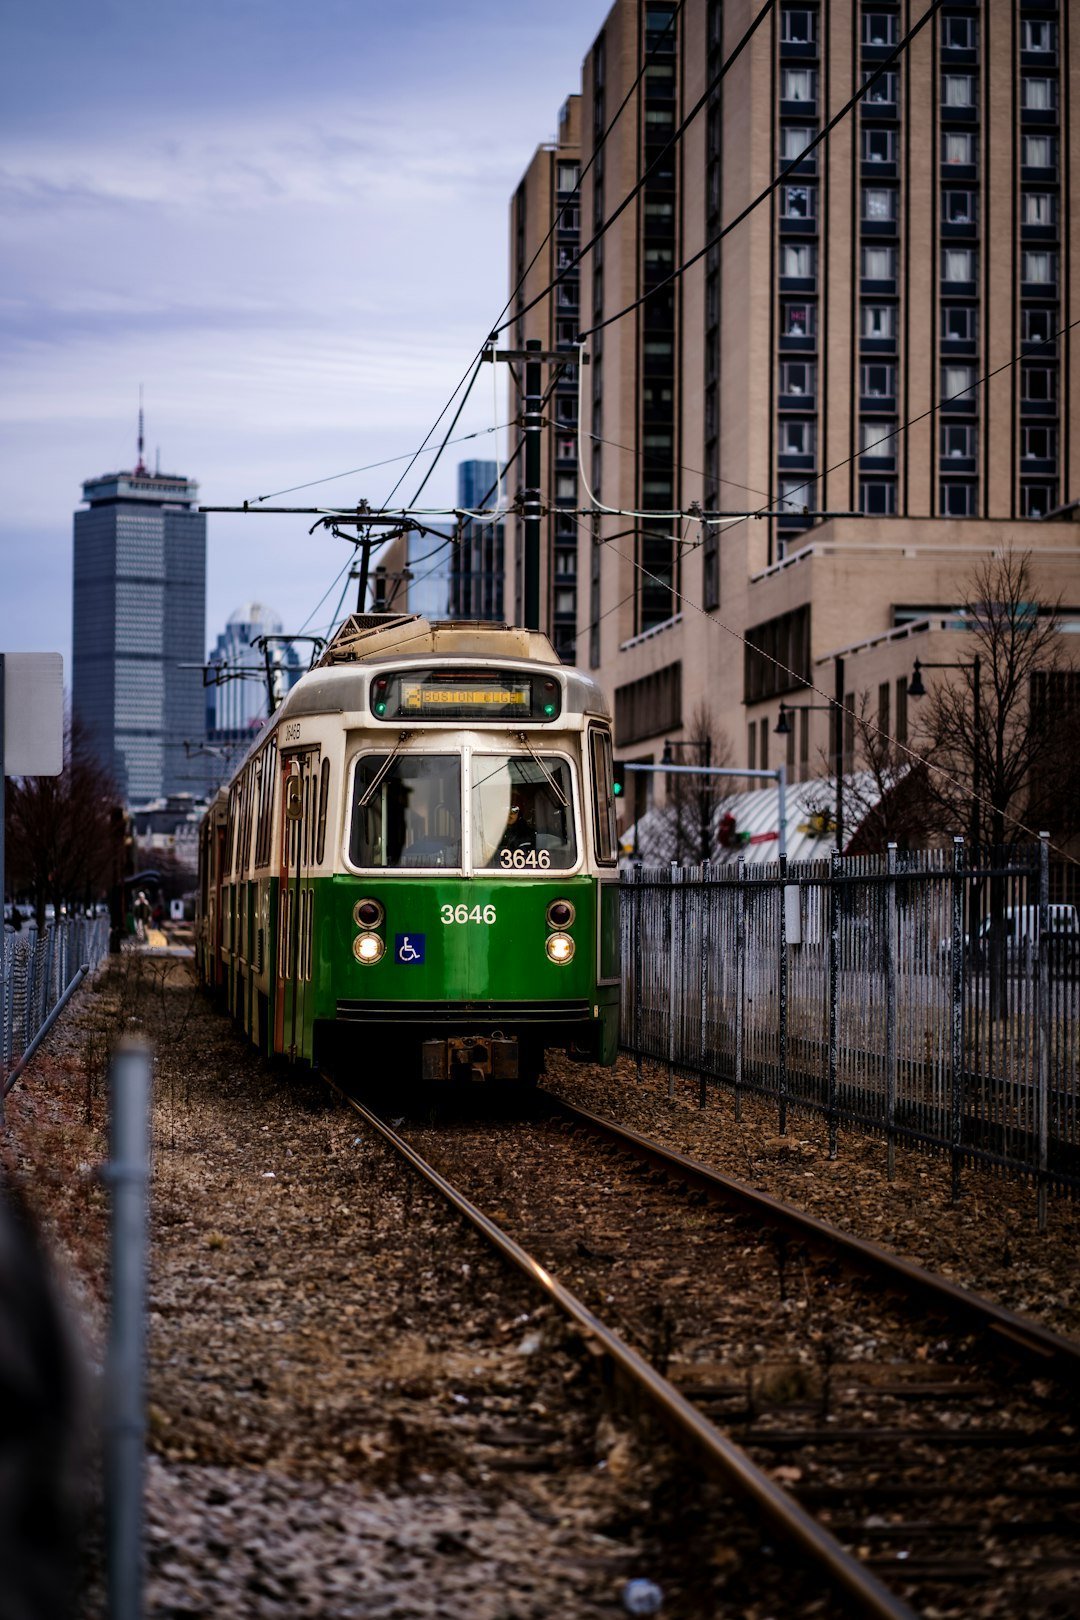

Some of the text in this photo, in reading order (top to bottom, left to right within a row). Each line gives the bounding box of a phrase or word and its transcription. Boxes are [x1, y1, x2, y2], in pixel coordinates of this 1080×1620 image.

[424, 691, 474, 702] BOSTON
[500, 849, 551, 869] 3646
[440, 904, 497, 925] 3646
